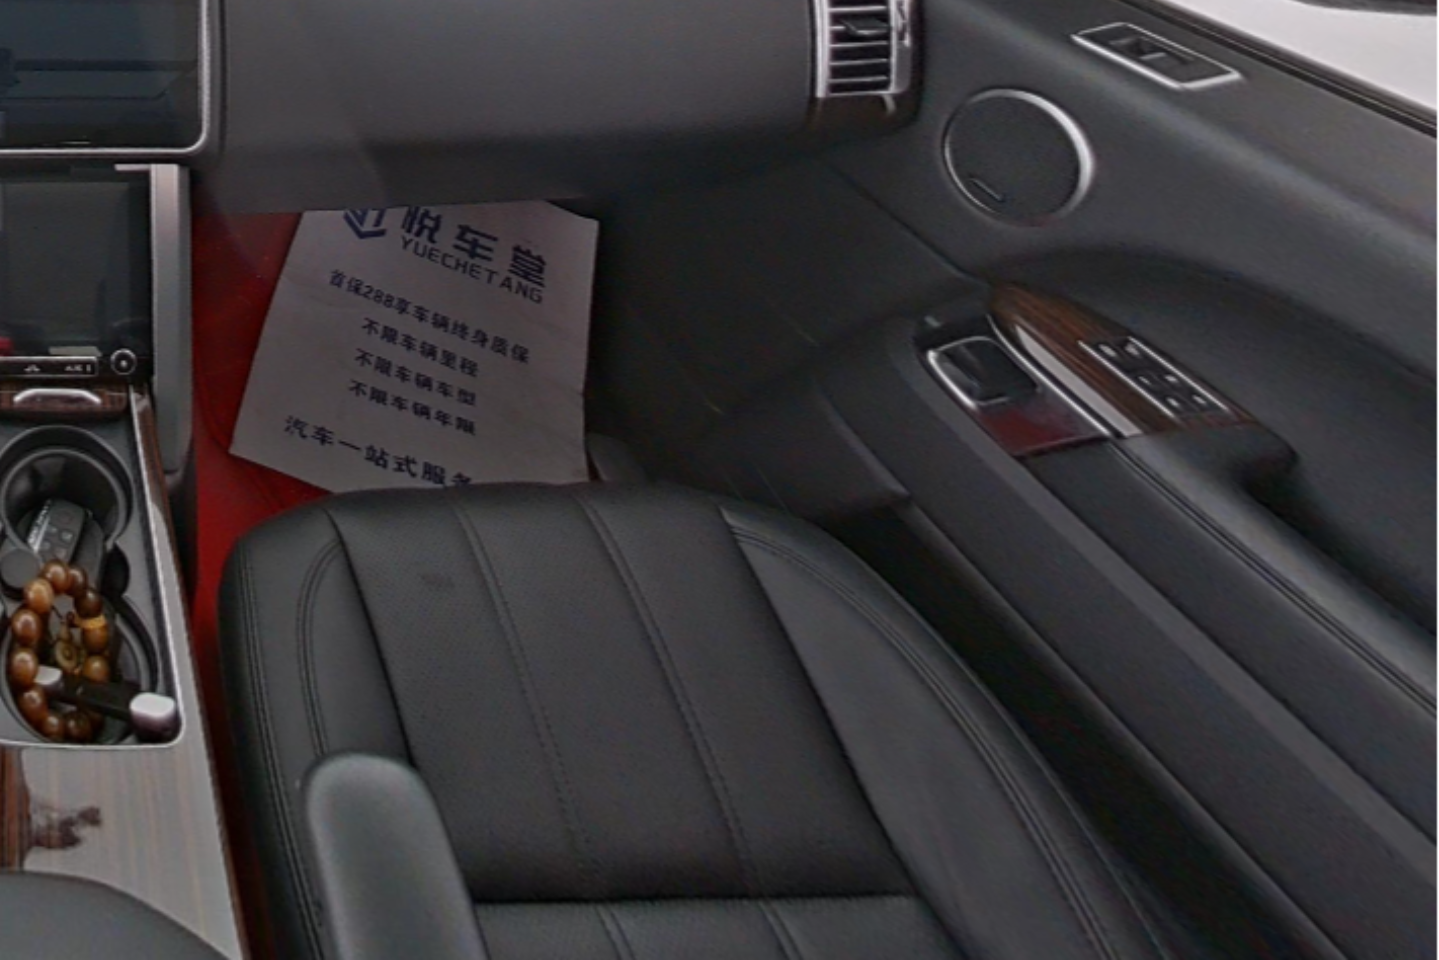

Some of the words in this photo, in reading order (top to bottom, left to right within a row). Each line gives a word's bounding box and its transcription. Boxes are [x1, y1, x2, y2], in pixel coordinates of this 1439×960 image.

[399, 205, 548, 289] 悦车堂
[399, 237, 545, 304] YUECHETANG
[354, 347, 477, 408] 不限车辆车型
[361, 317, 479, 379] 不限车辆里程
[348, 378, 477, 437] 不限车辆年限
